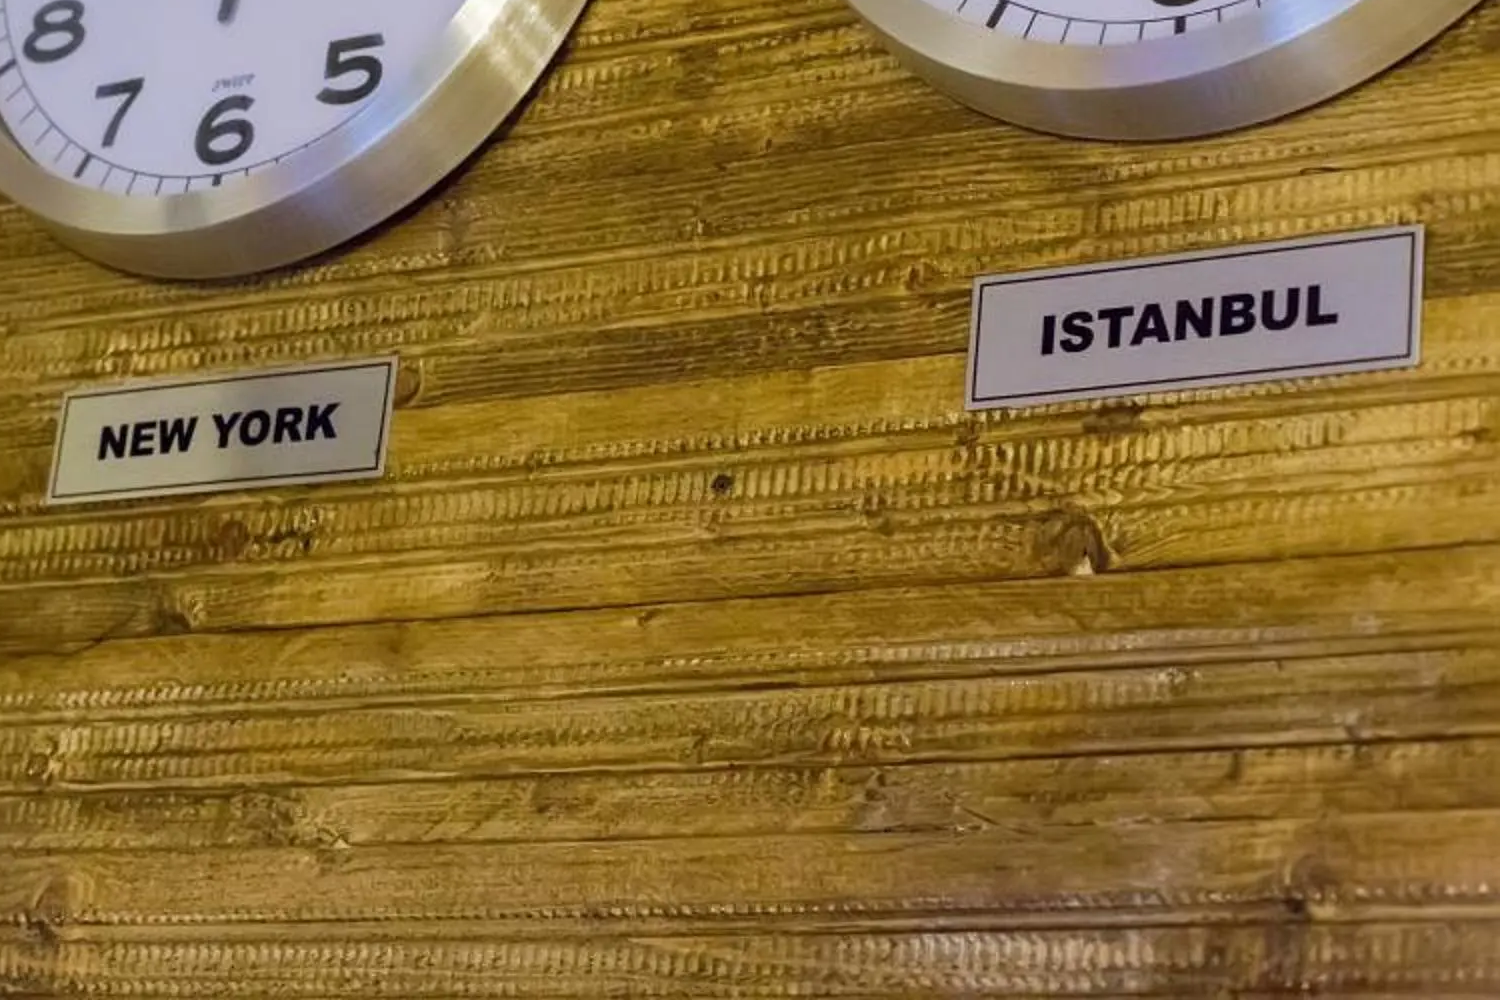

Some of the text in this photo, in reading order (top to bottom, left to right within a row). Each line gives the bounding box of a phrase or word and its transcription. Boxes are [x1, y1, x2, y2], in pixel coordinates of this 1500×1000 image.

[316, 32, 385, 105] 5
[95, 78, 145, 148] 7
[195, 95, 254, 165] 6
[1039, 284, 1340, 357] ISTANBUL
[97, 402, 340, 460] NEW YORK
